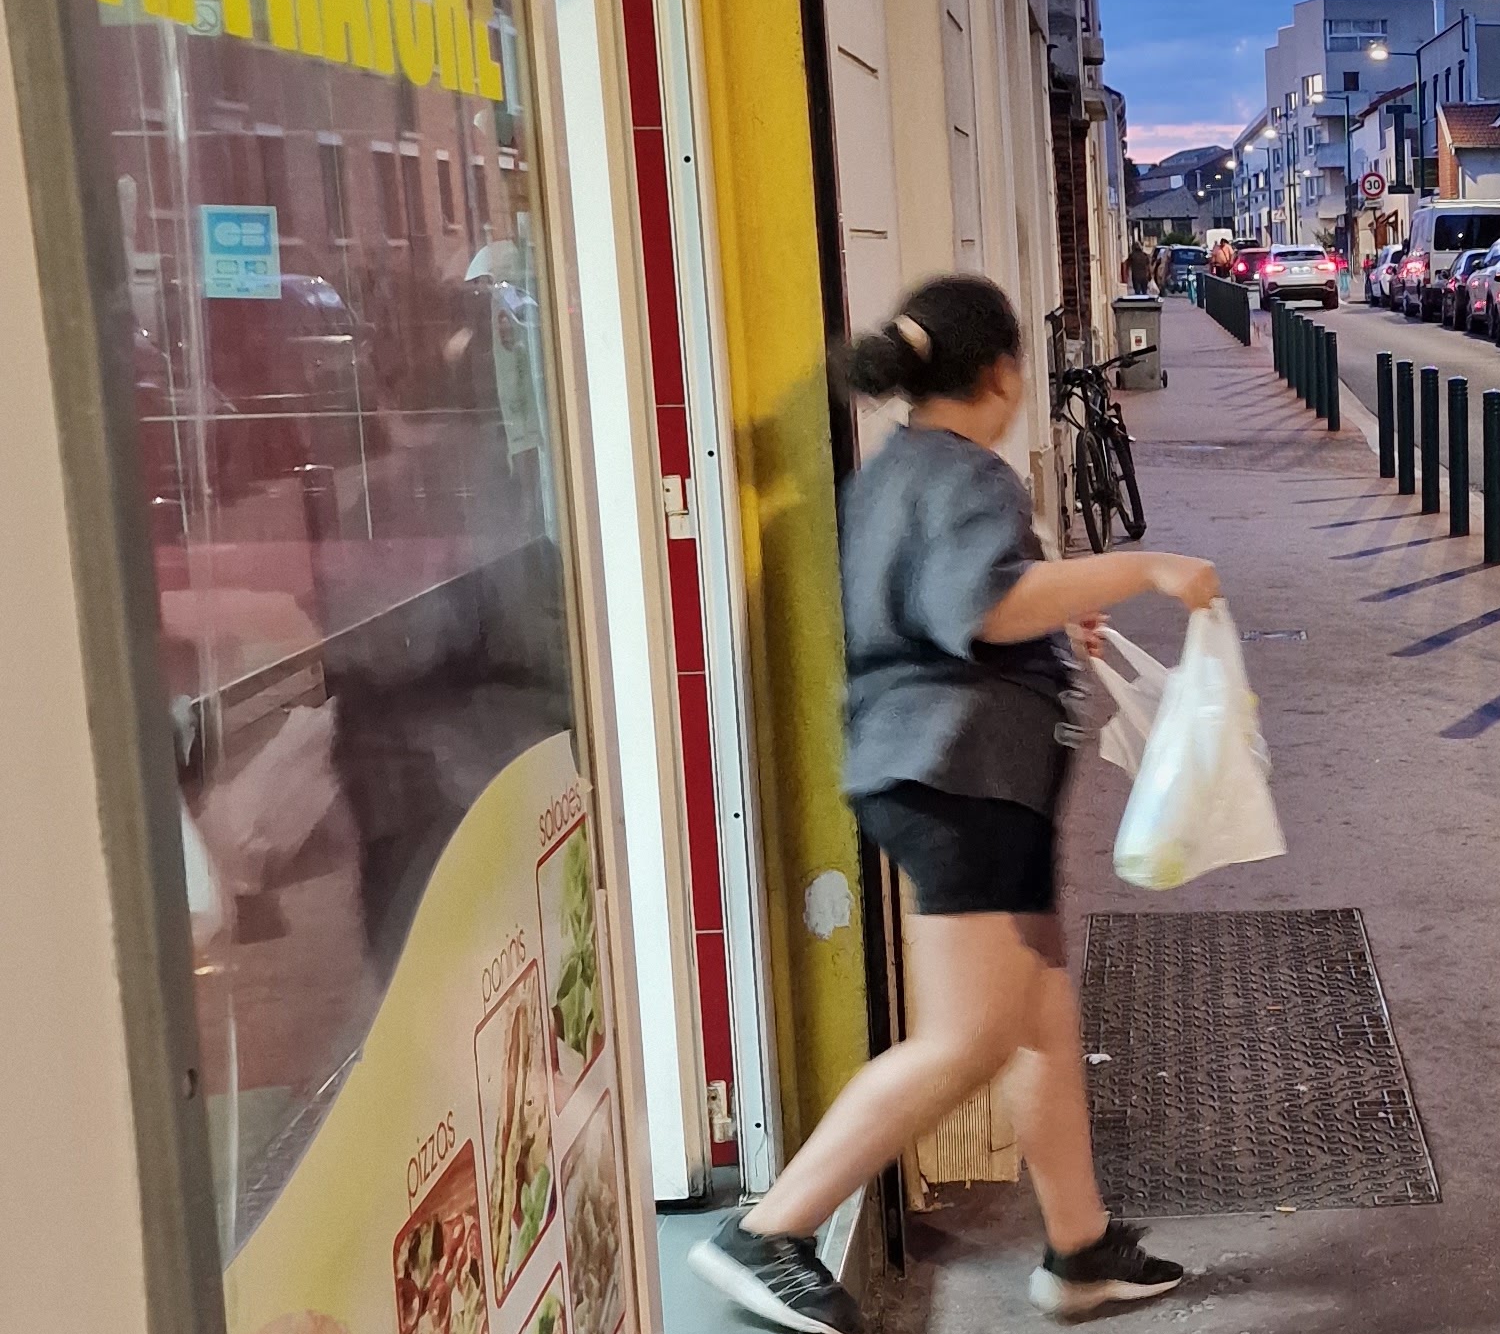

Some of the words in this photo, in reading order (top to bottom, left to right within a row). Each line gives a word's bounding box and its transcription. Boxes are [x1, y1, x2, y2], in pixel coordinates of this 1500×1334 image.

[1366, 179, 1381, 191] 30
[539, 782, 582, 847] salades
[482, 923, 526, 1016] paninis
[407, 1110, 456, 1216] pizzas
